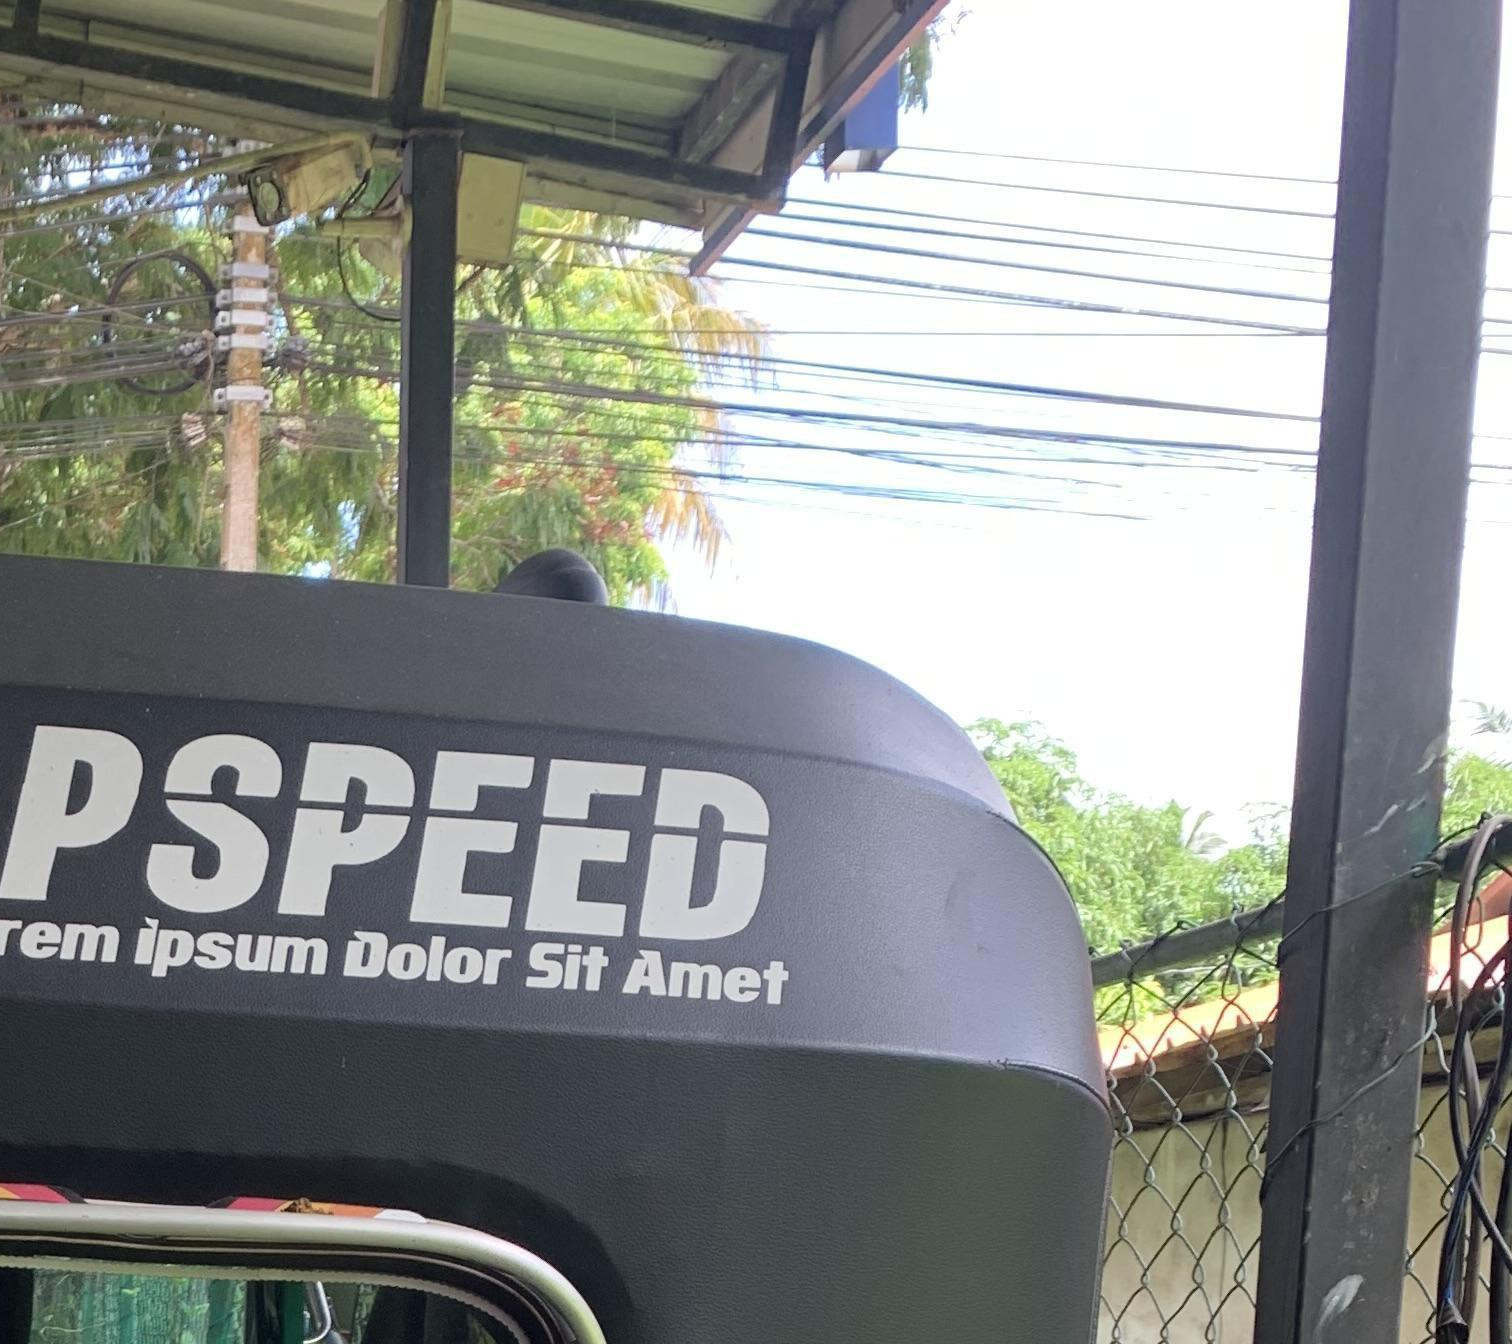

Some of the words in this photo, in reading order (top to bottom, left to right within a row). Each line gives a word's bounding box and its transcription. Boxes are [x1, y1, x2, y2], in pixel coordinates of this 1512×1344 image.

[342, 930, 513, 986] Dolor
[525, 942, 610, 992] Sit
[621, 949, 790, 1006] Amet
